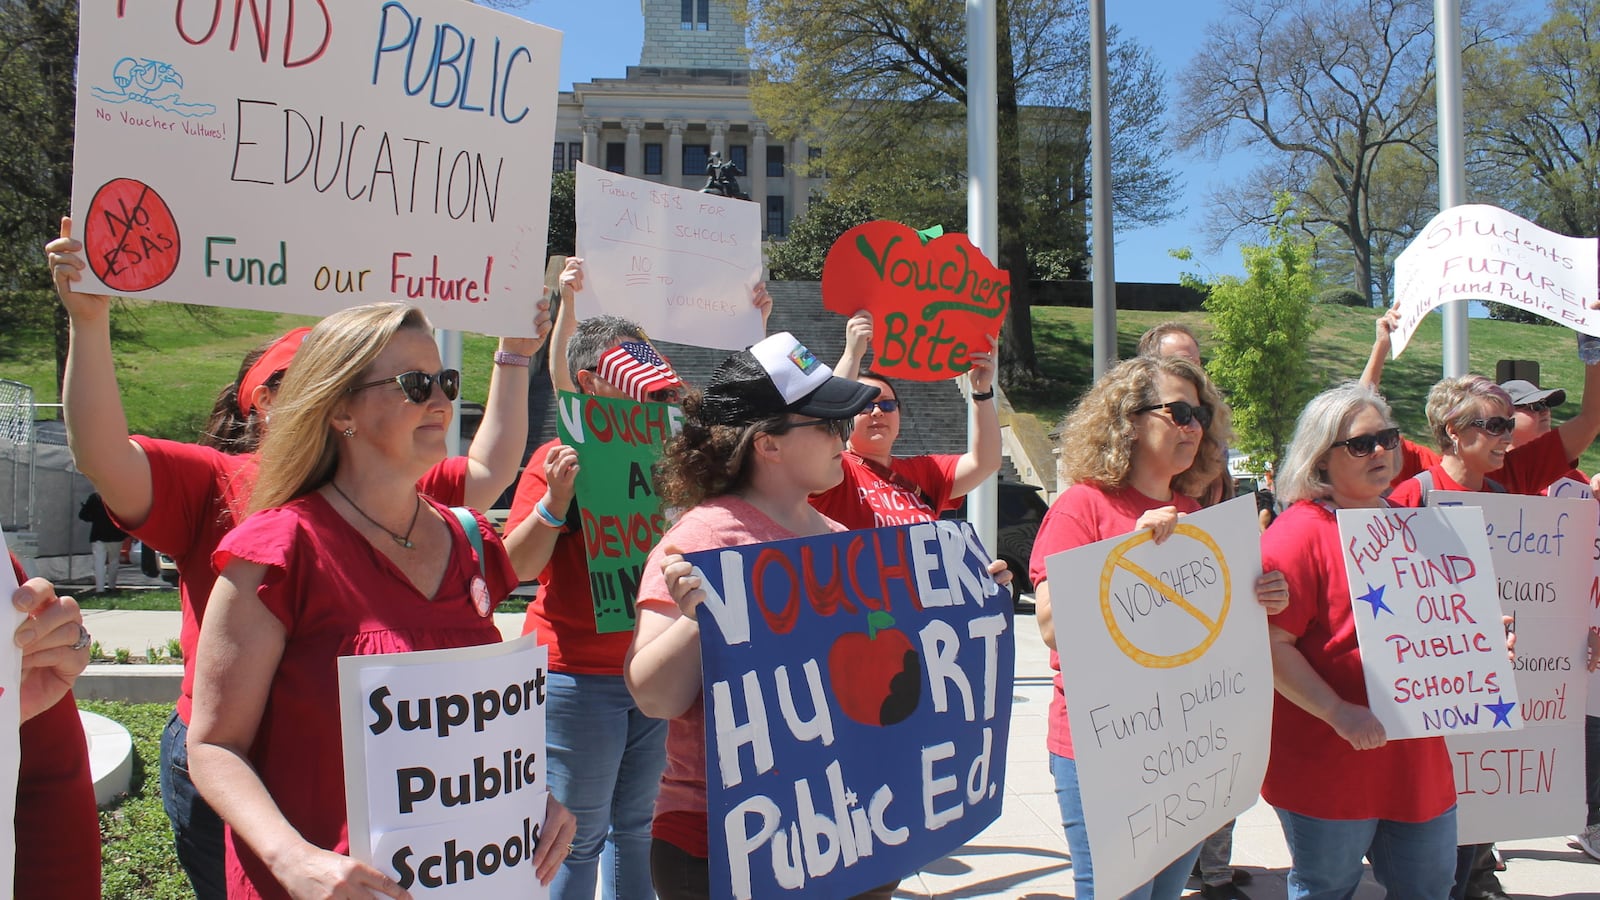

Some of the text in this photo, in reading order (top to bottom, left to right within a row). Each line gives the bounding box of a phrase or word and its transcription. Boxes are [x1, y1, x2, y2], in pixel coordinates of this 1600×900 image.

[117, 0, 531, 124] UND PUBLIC
[96, 108, 226, 140] No Voucher Vultures!
[231, 99, 504, 223] EDUCATION
[615, 207, 738, 247] ALL SCHOOLS
[649, 188, 683, 210] $$$
[698, 203, 727, 217] FOR
[204, 236, 287, 286] Fund
[314, 265, 371, 294] our
[390, 252, 493, 303] Future!
[631, 255, 653, 273] NO
[856, 234, 1009, 308] Vouchers
[1427, 216, 1573, 270] Students
[665, 295, 737, 317] VOUCHERS
[1402, 296, 1431, 341] Fully
[1438, 281, 1493, 300] Fund
[1500, 282, 1557, 315] Public
[880, 312, 972, 372] Bite
[559, 396, 683, 447] VOUCHE
[857, 485, 931, 511] PENCIL
[1349, 511, 1418, 575] Fully
[1392, 554, 1476, 589] FUND
[690, 520, 999, 646] VOUCHERS
[1114, 556, 1217, 623] VOUCHERS
[1416, 593, 1476, 625] OUR
[1385, 632, 1492, 664] PUBLIC
[369, 667, 546, 737] Support
[1088, 667, 1246, 749] Fund public
[1394, 671, 1501, 703] SCHOOLS
[1422, 703, 1480, 731] NOW
[396, 748, 535, 814] Public
[1141, 719, 1228, 785] schools
[1456, 748, 1556, 796] ISTEN
[724, 727, 997, 900] Public Ed.
[1127, 751, 1242, 860] FIRST!
